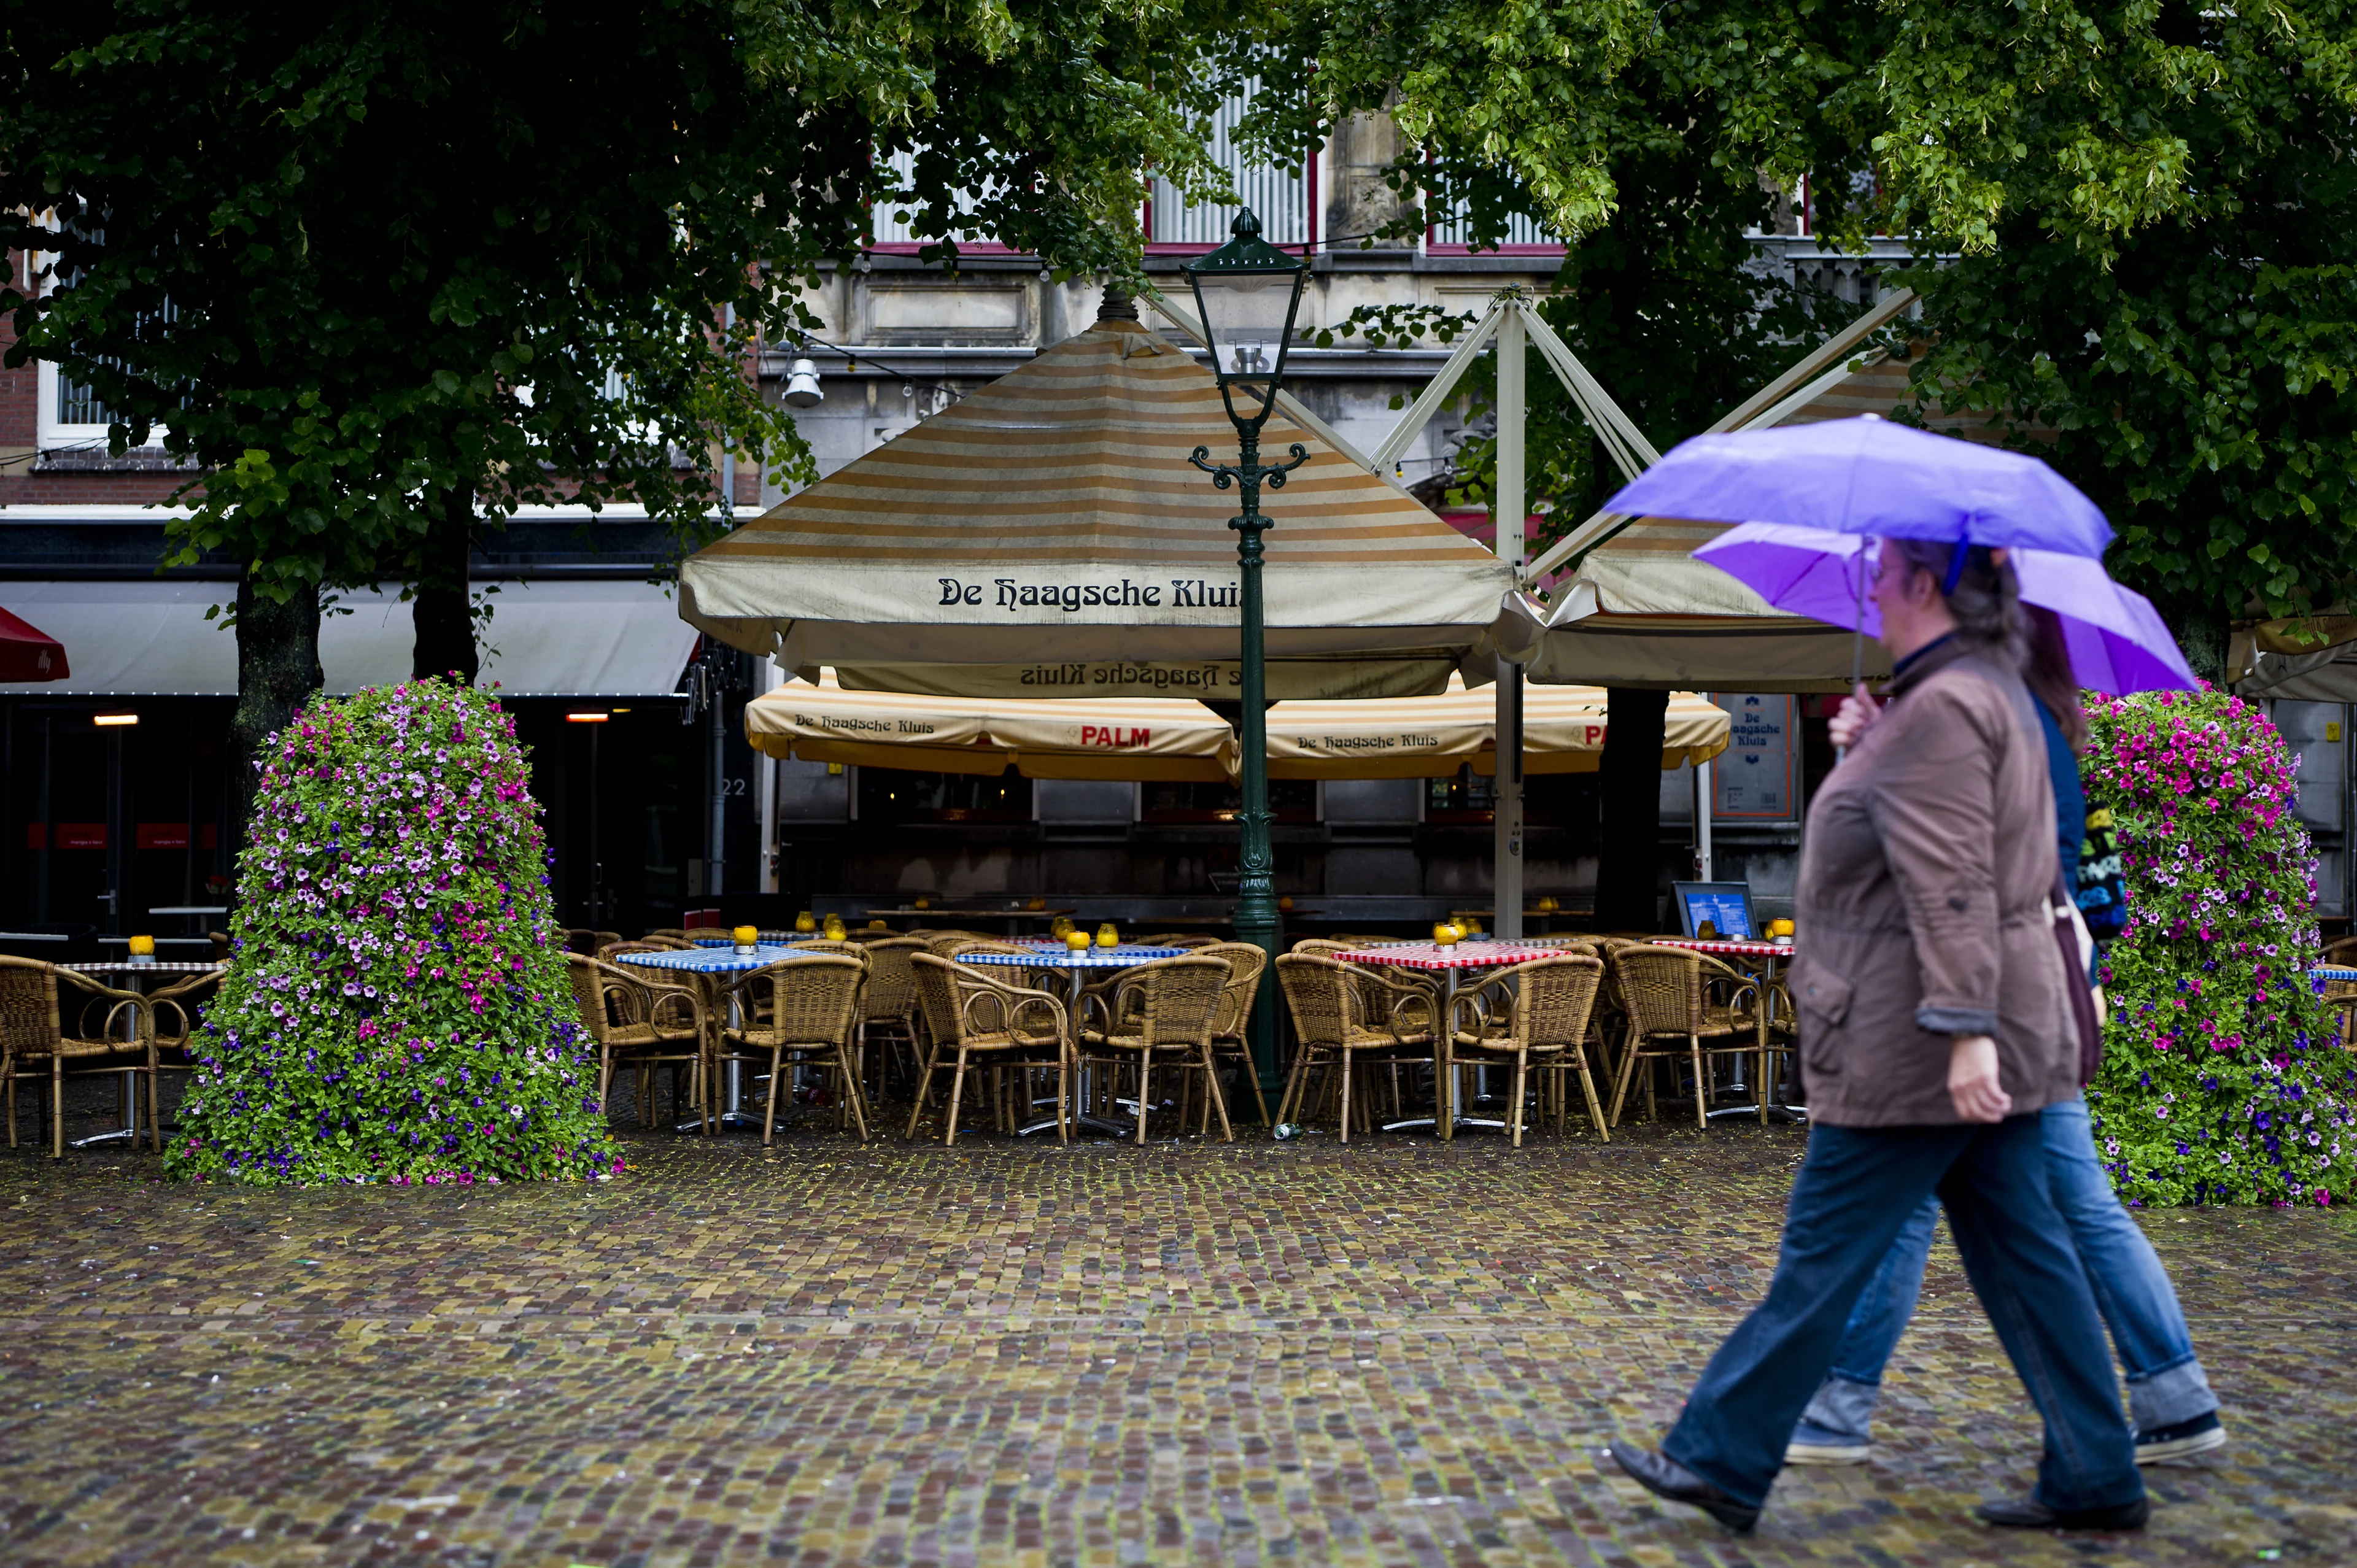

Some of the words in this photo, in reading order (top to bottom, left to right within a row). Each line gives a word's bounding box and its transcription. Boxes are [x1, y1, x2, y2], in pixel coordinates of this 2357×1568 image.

[938, 578, 982, 606] De
[994, 579, 1161, 612] Haagsche
[1171, 580, 1241, 608] Klui
[37, 649, 52, 674] illy
[795, 714, 814, 727] De
[821, 716, 891, 732] Haagsche
[898, 720, 935, 734] Kluis
[1730, 724, 1780, 735] aagsche
[1081, 725, 1150, 747] PALM
[1297, 736, 1317, 750] De
[1324, 736, 1395, 750] Haagsche
[1401, 734, 1439, 747] Kluis
